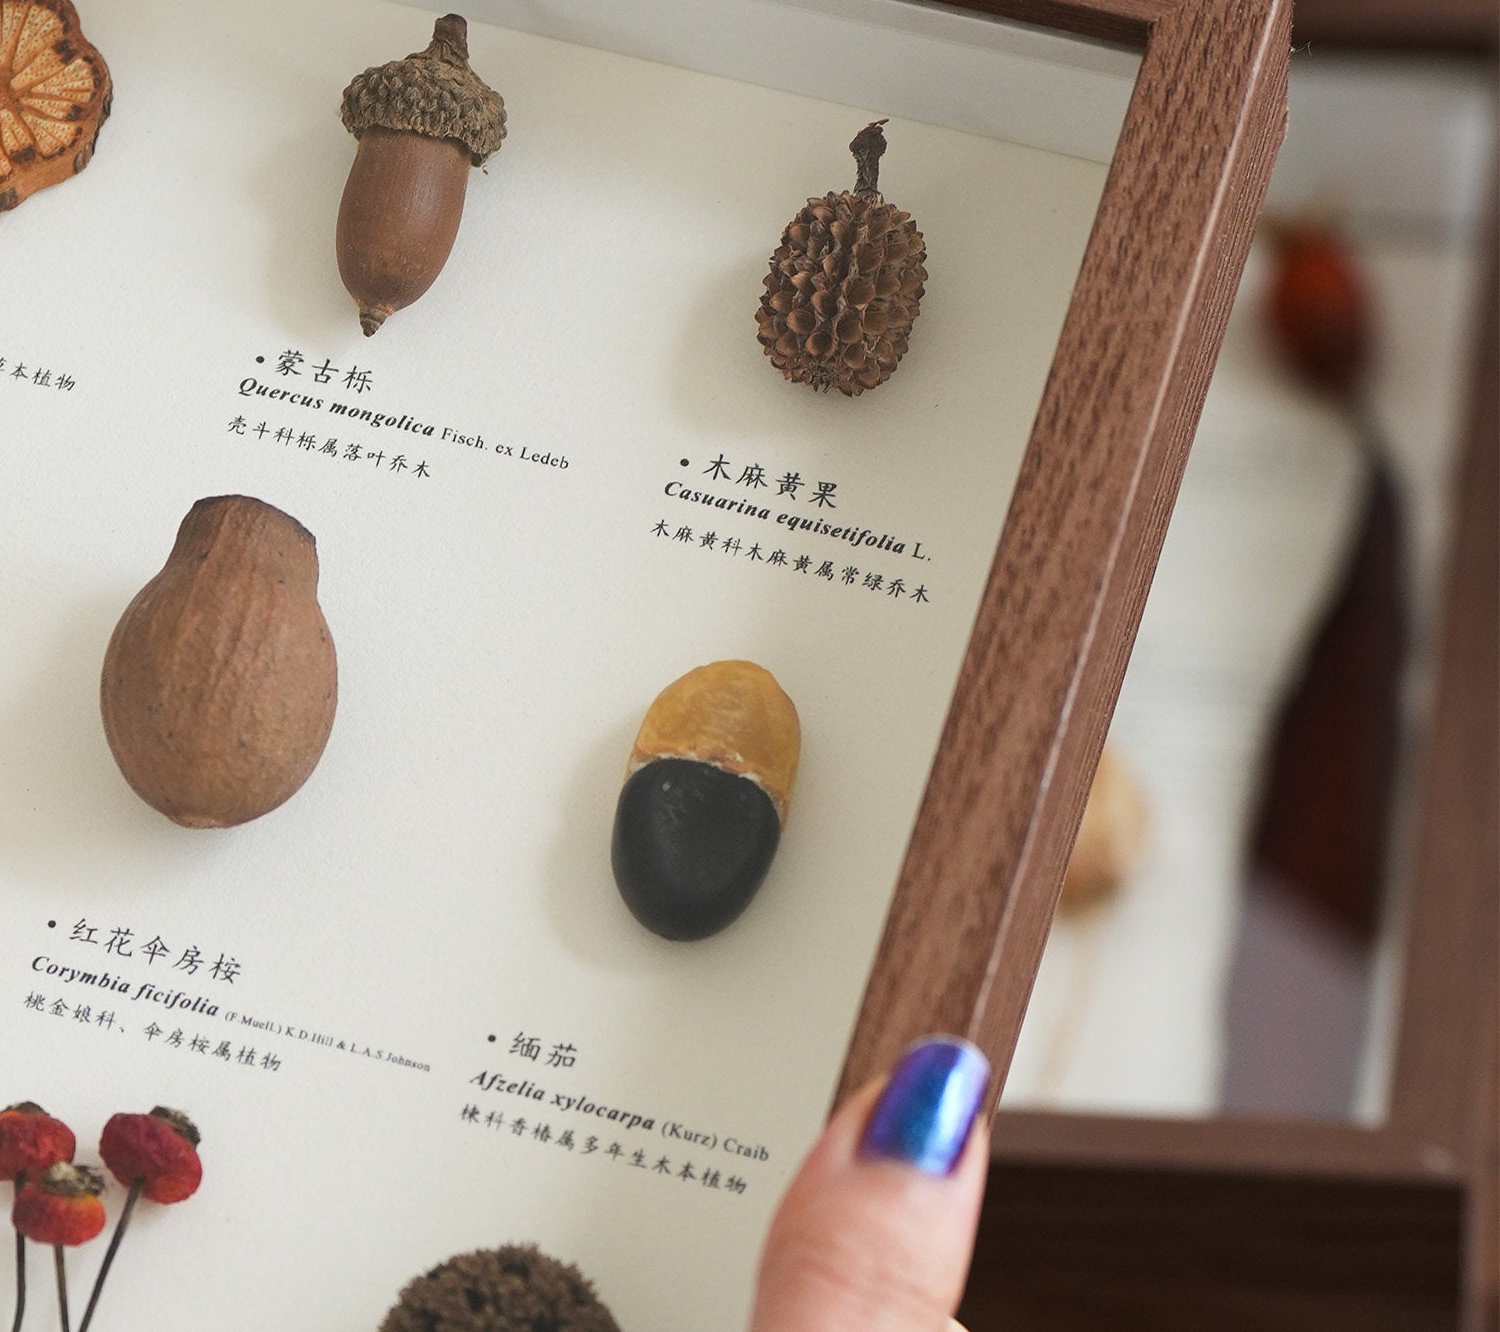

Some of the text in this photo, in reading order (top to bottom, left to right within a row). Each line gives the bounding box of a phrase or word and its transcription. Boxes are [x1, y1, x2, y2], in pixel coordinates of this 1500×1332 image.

[275, 349, 373, 394] 蒙古栎
[227, 415, 431, 479] 壳斗科栎属落叶乔木
[238, 378, 570, 470] Quercus mongolica Fisch. ex Ledeb
[702, 453, 838, 509] 木麻黄果
[664, 481, 931, 561] Casuarina equisetifolia L.
[650, 519, 930, 604] 木麻黄科木麻黄属常绿乔木
[69, 918, 243, 985] 红花伞房桉
[31, 955, 131, 994] Corymbia
[132, 983, 219, 1017] ficifolia
[336, 1040, 347, 1051] &
[508, 1031, 578, 1068] 缅茄
[469, 1070, 770, 1163] Afzelia xylocarpa (Kurz) Craib
